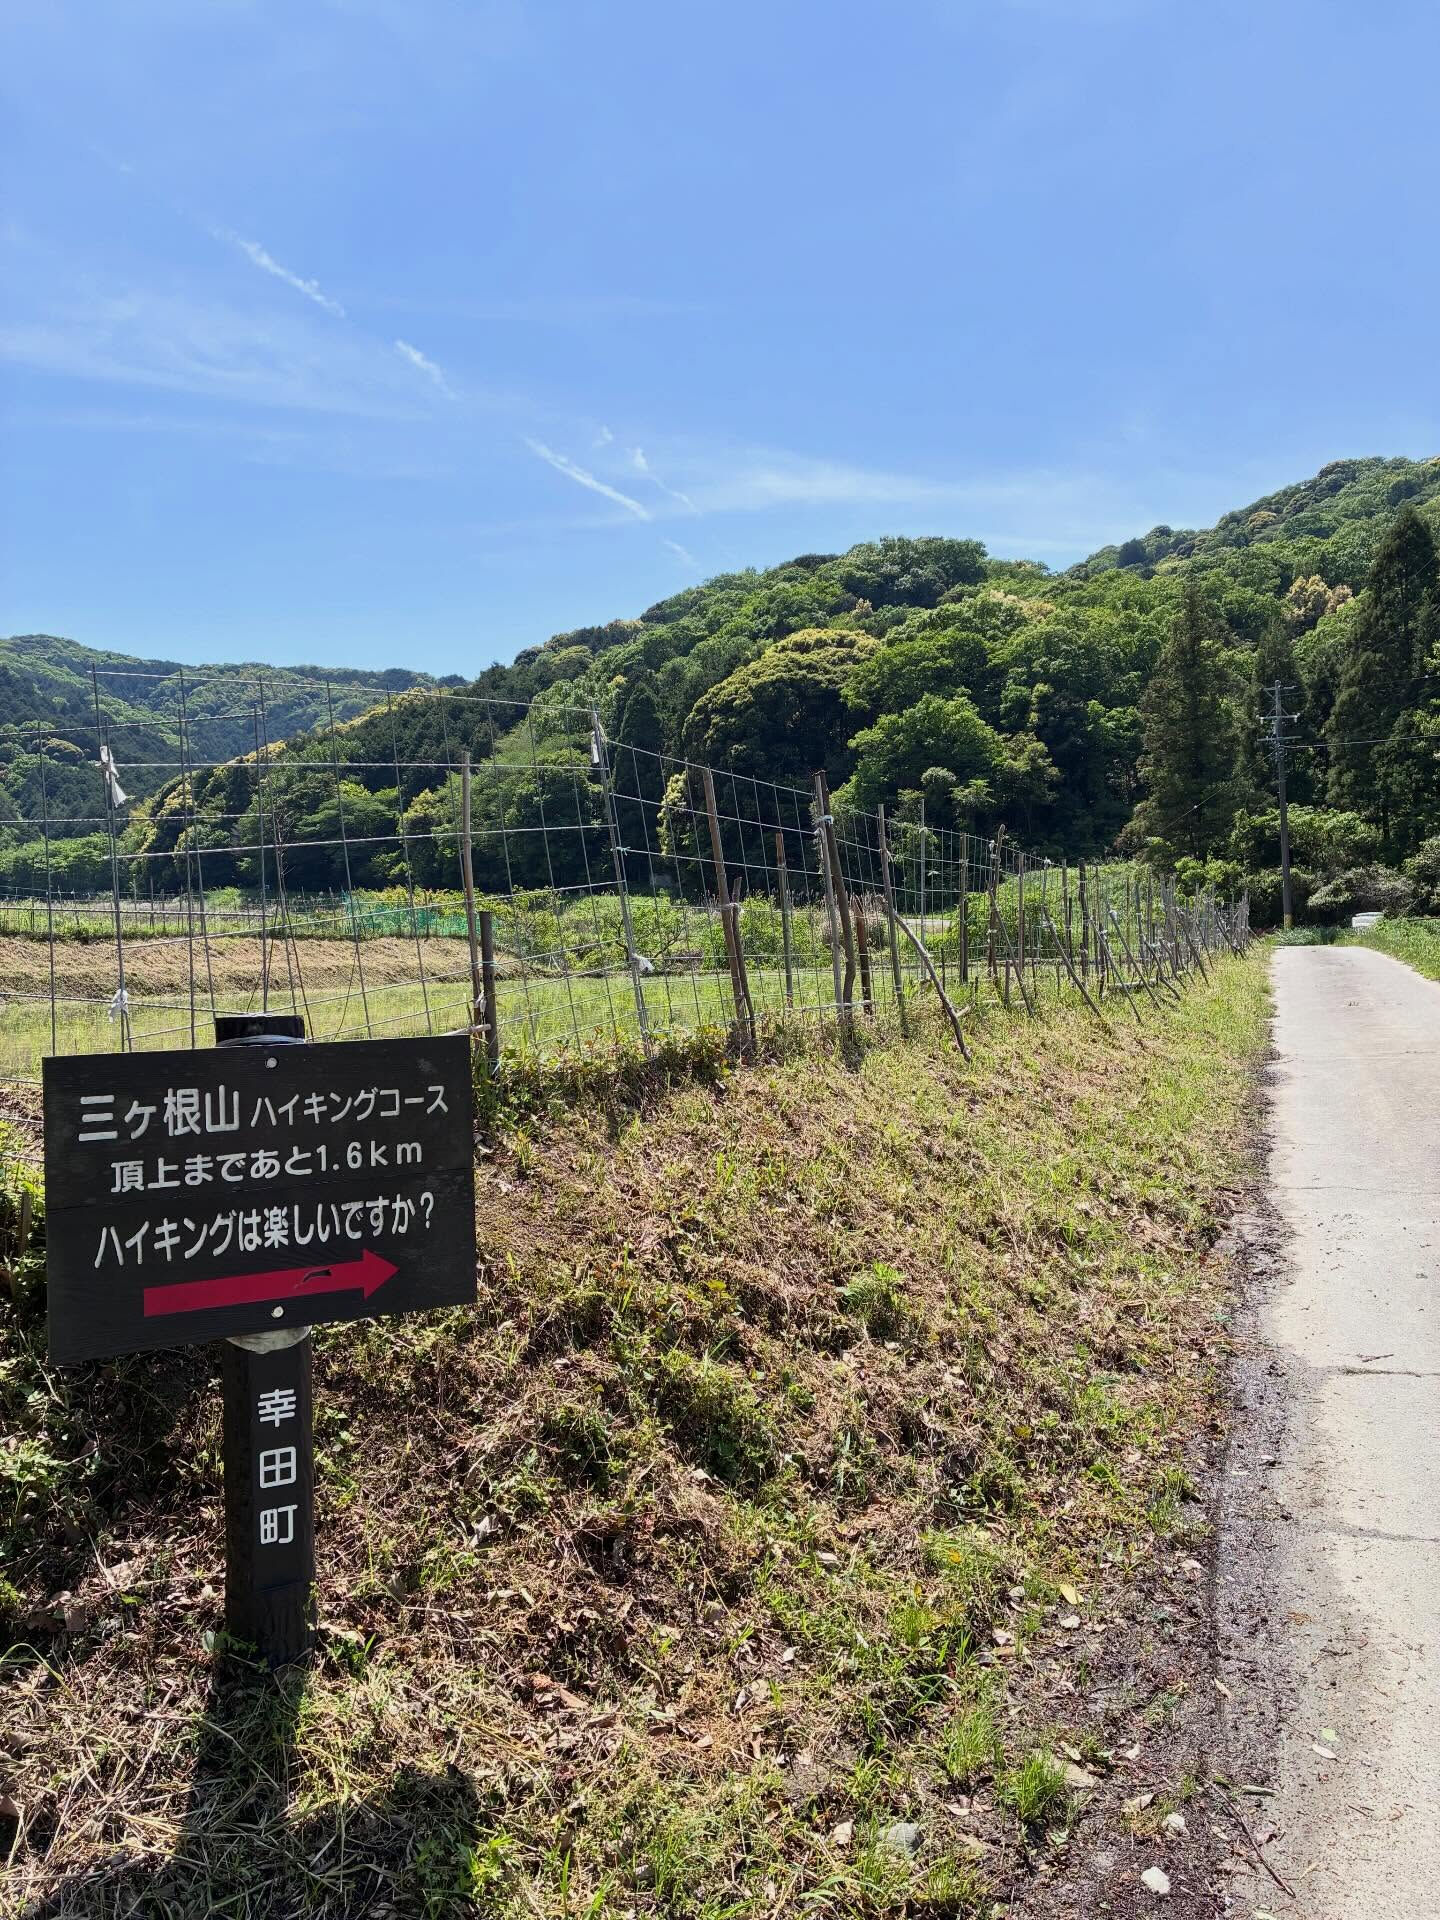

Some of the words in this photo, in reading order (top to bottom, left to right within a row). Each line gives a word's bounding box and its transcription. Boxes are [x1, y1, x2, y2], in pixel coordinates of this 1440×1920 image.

[250, 1084, 450, 1129] ハイキングコース
[110, 1139, 423, 1193] 頂上まであと1.6km
[94, 1190, 436, 1269] ハイキングは楽しいですか?
[257, 1388, 299, 1545] 幸田町
